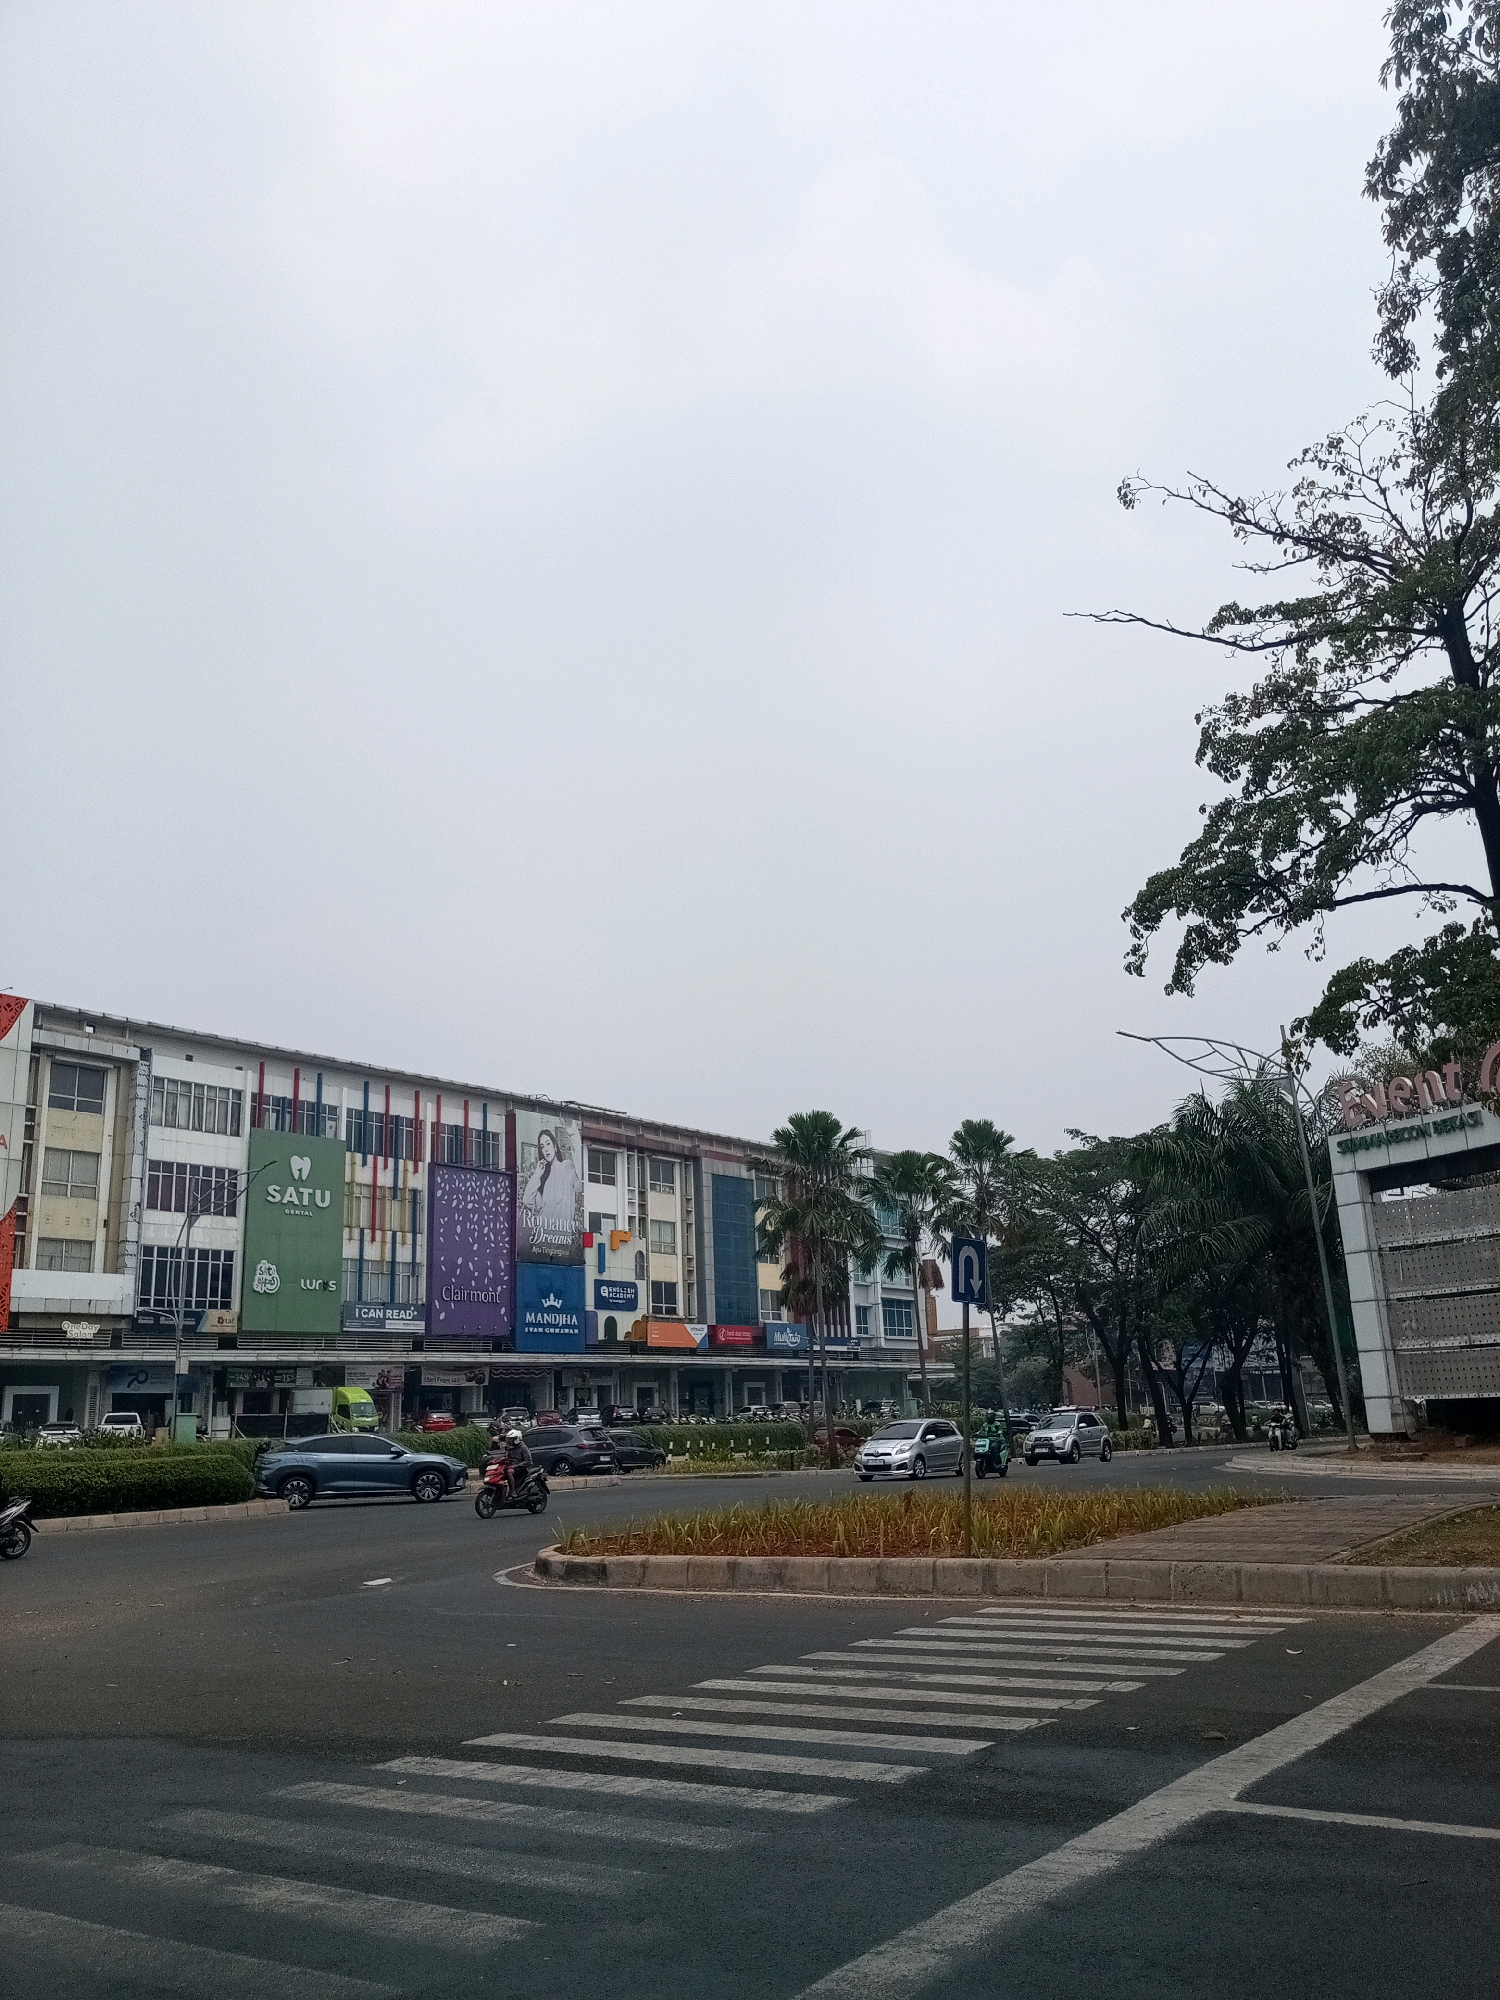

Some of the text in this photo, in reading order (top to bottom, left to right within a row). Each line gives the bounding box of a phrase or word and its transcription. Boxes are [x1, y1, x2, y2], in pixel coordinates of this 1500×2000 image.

[1338, 1055, 1463, 1128] Event
[266, 1184, 331, 1208] SATU
[285, 1208, 313, 1217] DENTAL
[522, 1208, 579, 1233] Romance
[529, 1225, 572, 1245] Dreams
[442, 1285, 501, 1303] Clairmont
[355, 1308, 414, 1320] I CAN READ
[525, 1312, 579, 1327] MANDJHA
[68, 1330, 92, 1338] Salon
